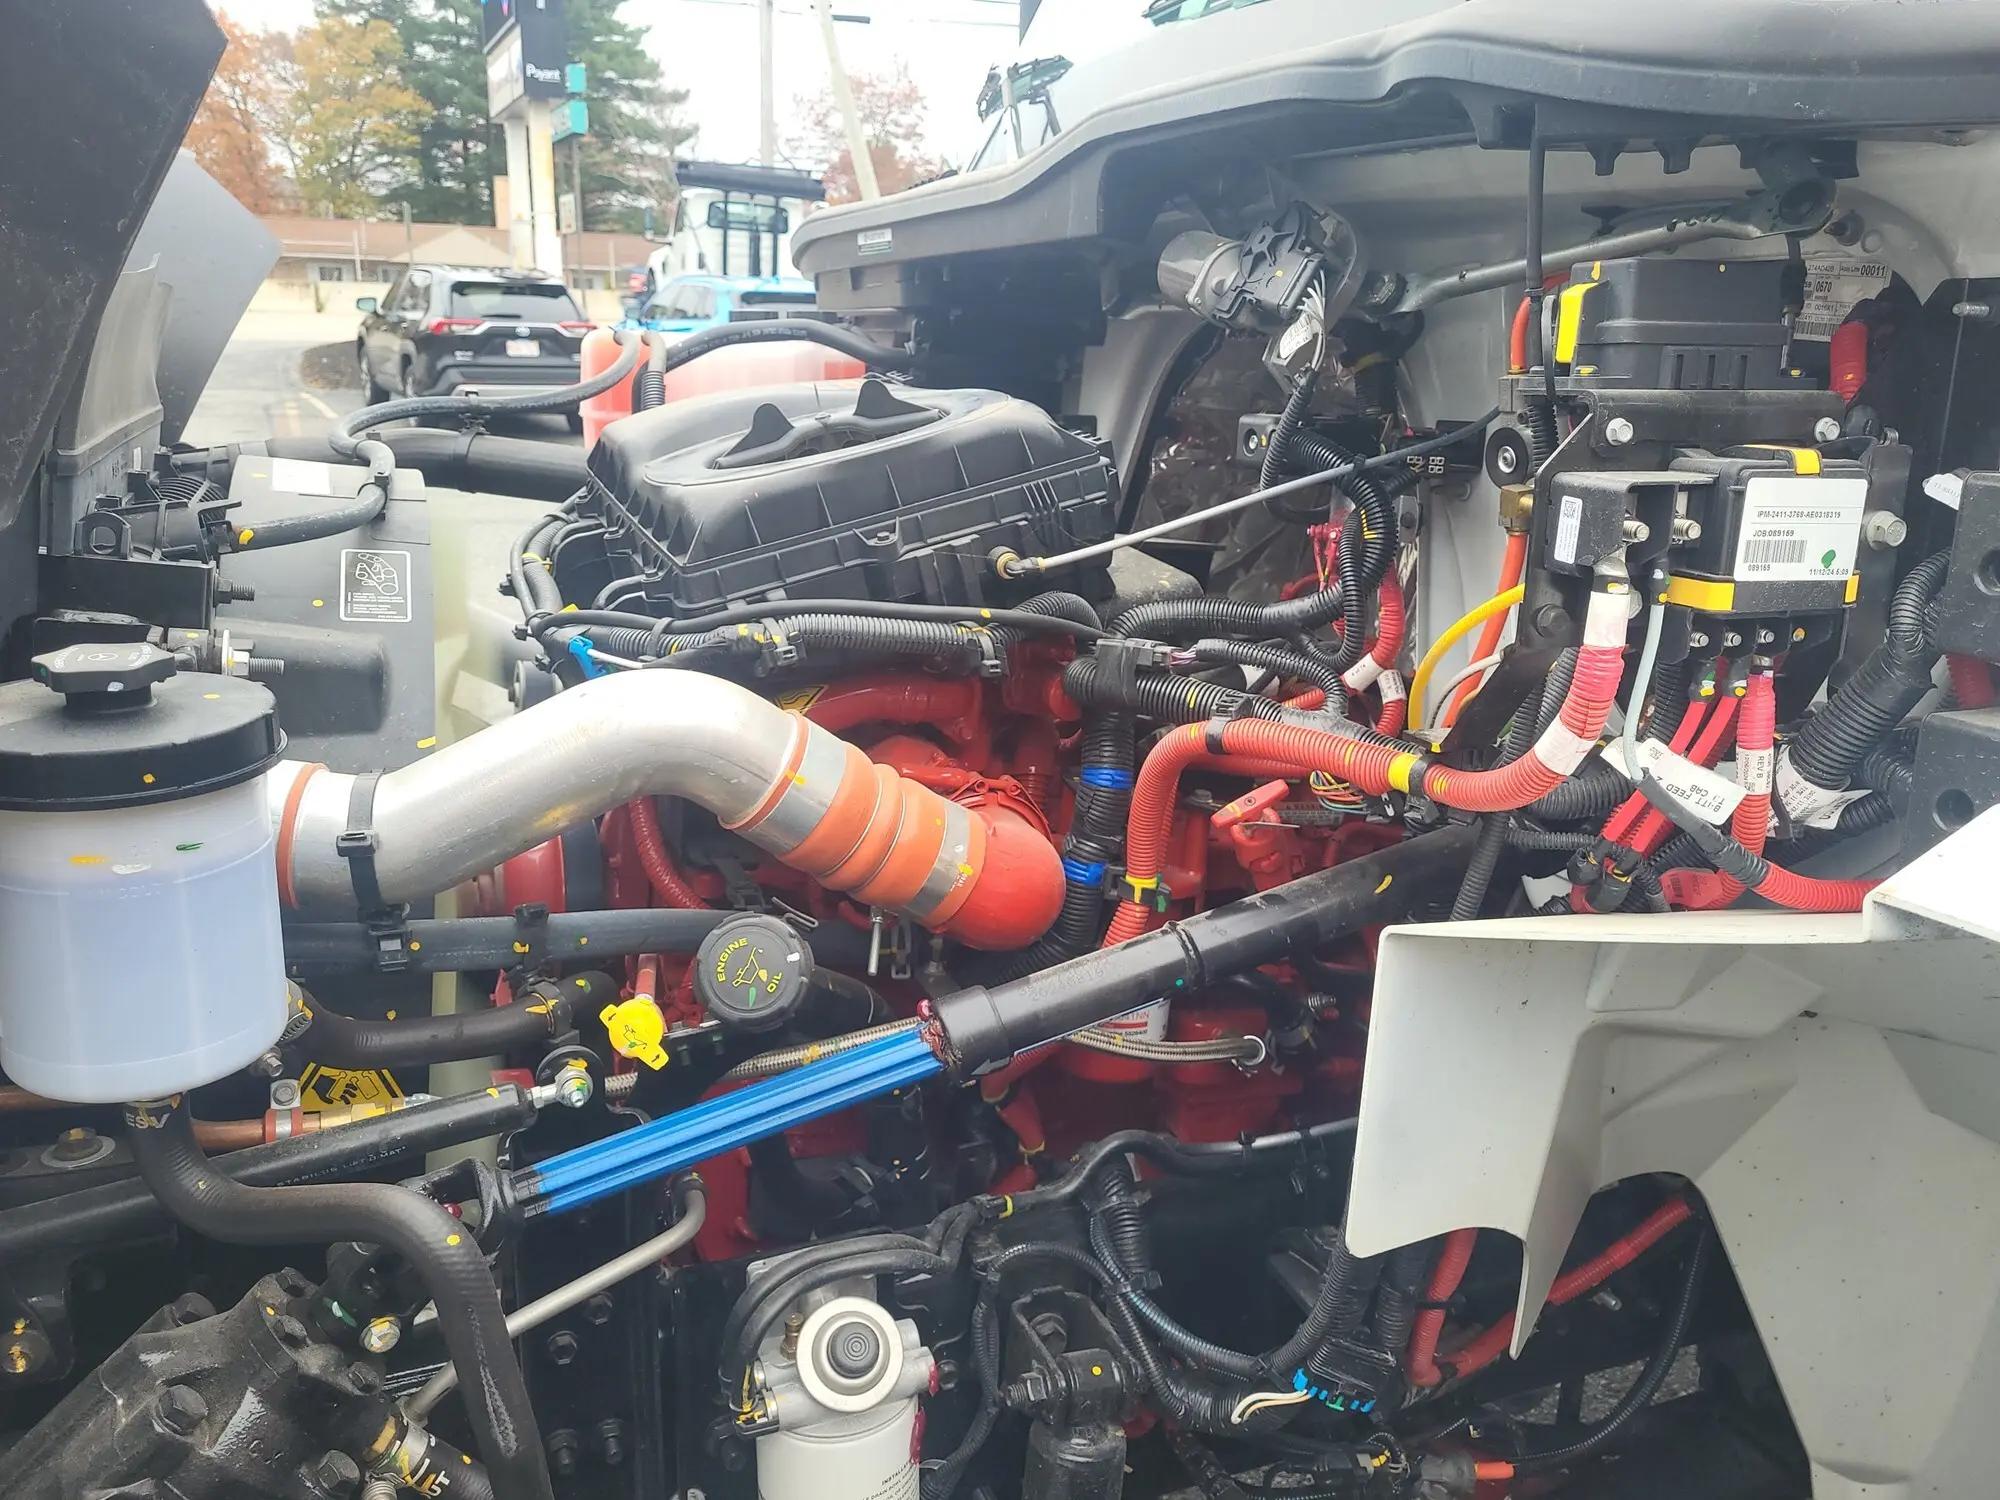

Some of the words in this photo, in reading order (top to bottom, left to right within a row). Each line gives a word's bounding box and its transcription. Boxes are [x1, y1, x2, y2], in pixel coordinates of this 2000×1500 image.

[1860, 264, 1886, 277] 00011
[1815, 280, 1833, 293] 0670
[1665, 783, 1693, 800] FEED
[1689, 784, 1709, 798] CAB
[716, 937, 749, 982] ENGINE
[766, 972, 783, 993] OIL
